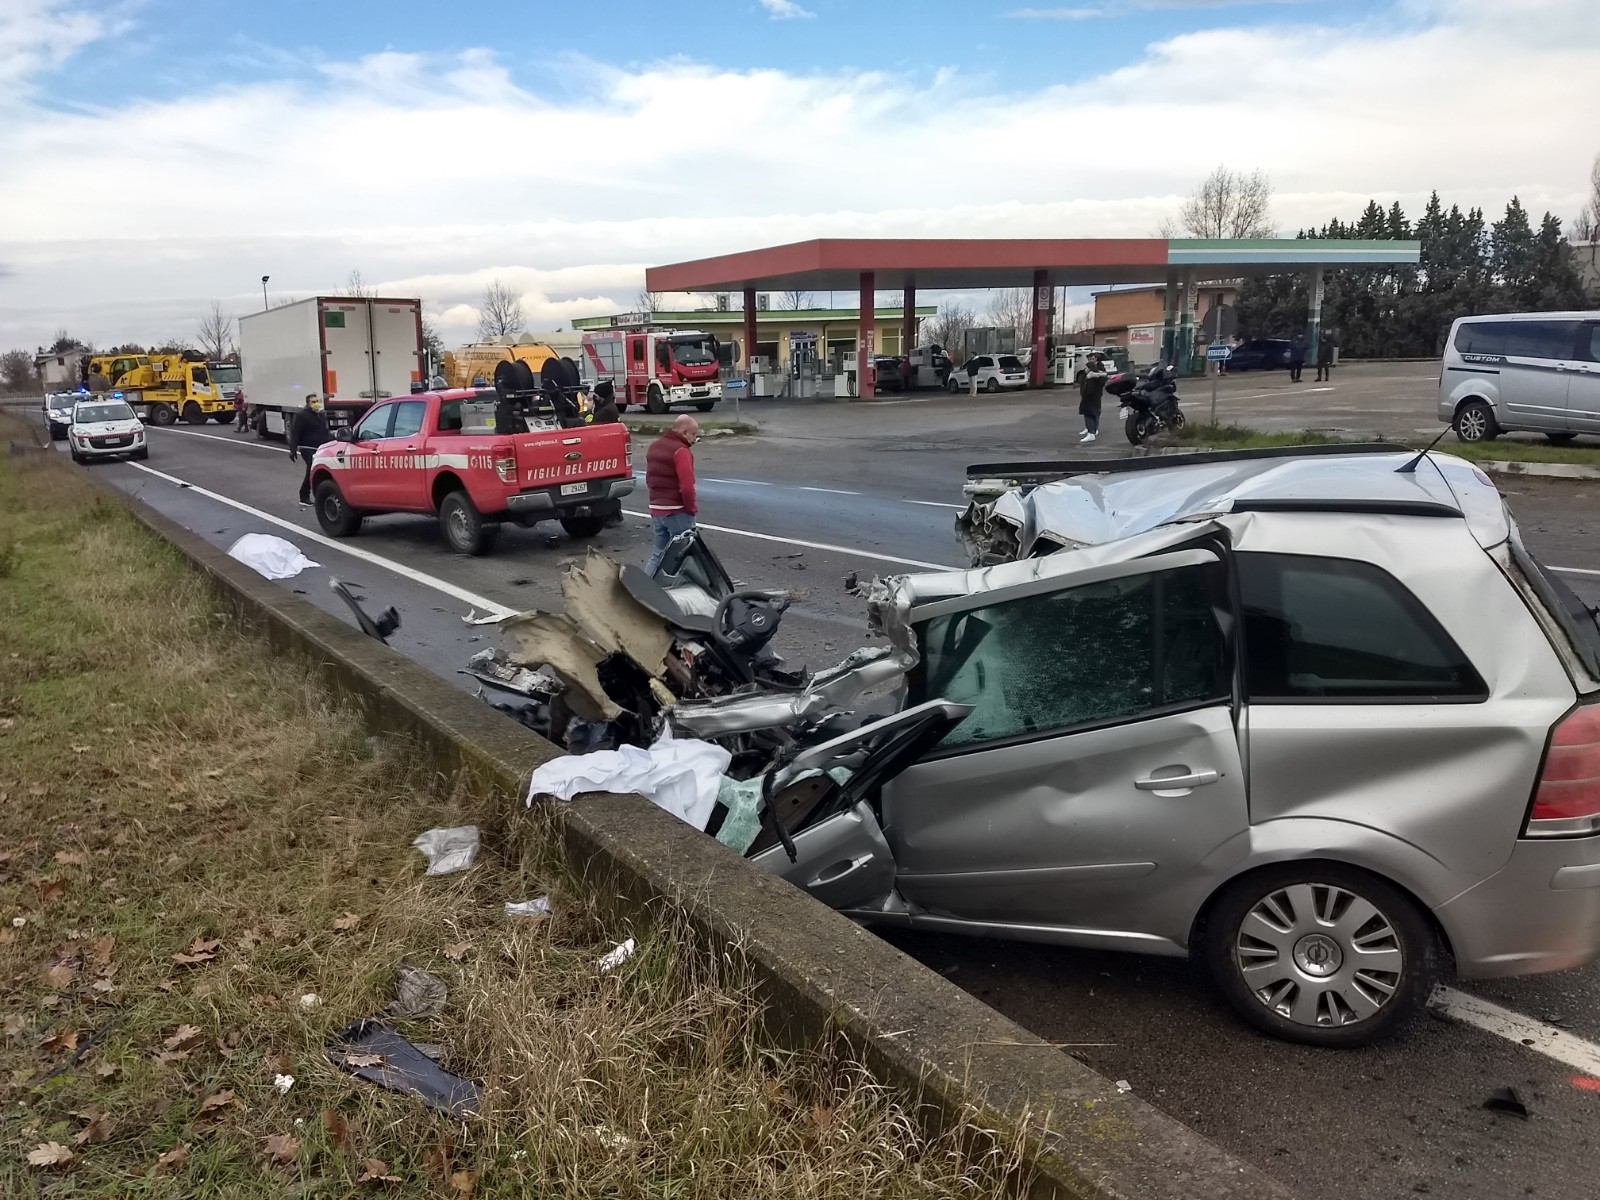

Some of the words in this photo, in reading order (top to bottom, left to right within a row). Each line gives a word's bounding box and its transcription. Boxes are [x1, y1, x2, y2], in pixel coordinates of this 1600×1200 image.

[351, 456, 372, 469] VIGILI
[375, 456, 388, 469] DEL
[390, 455, 414, 469] FUOCO
[478, 454, 493, 469] 115
[527, 466, 560, 480] VIGILI
[565, 463, 583, 475] DEL
[586, 458, 618, 472] FUOCO
